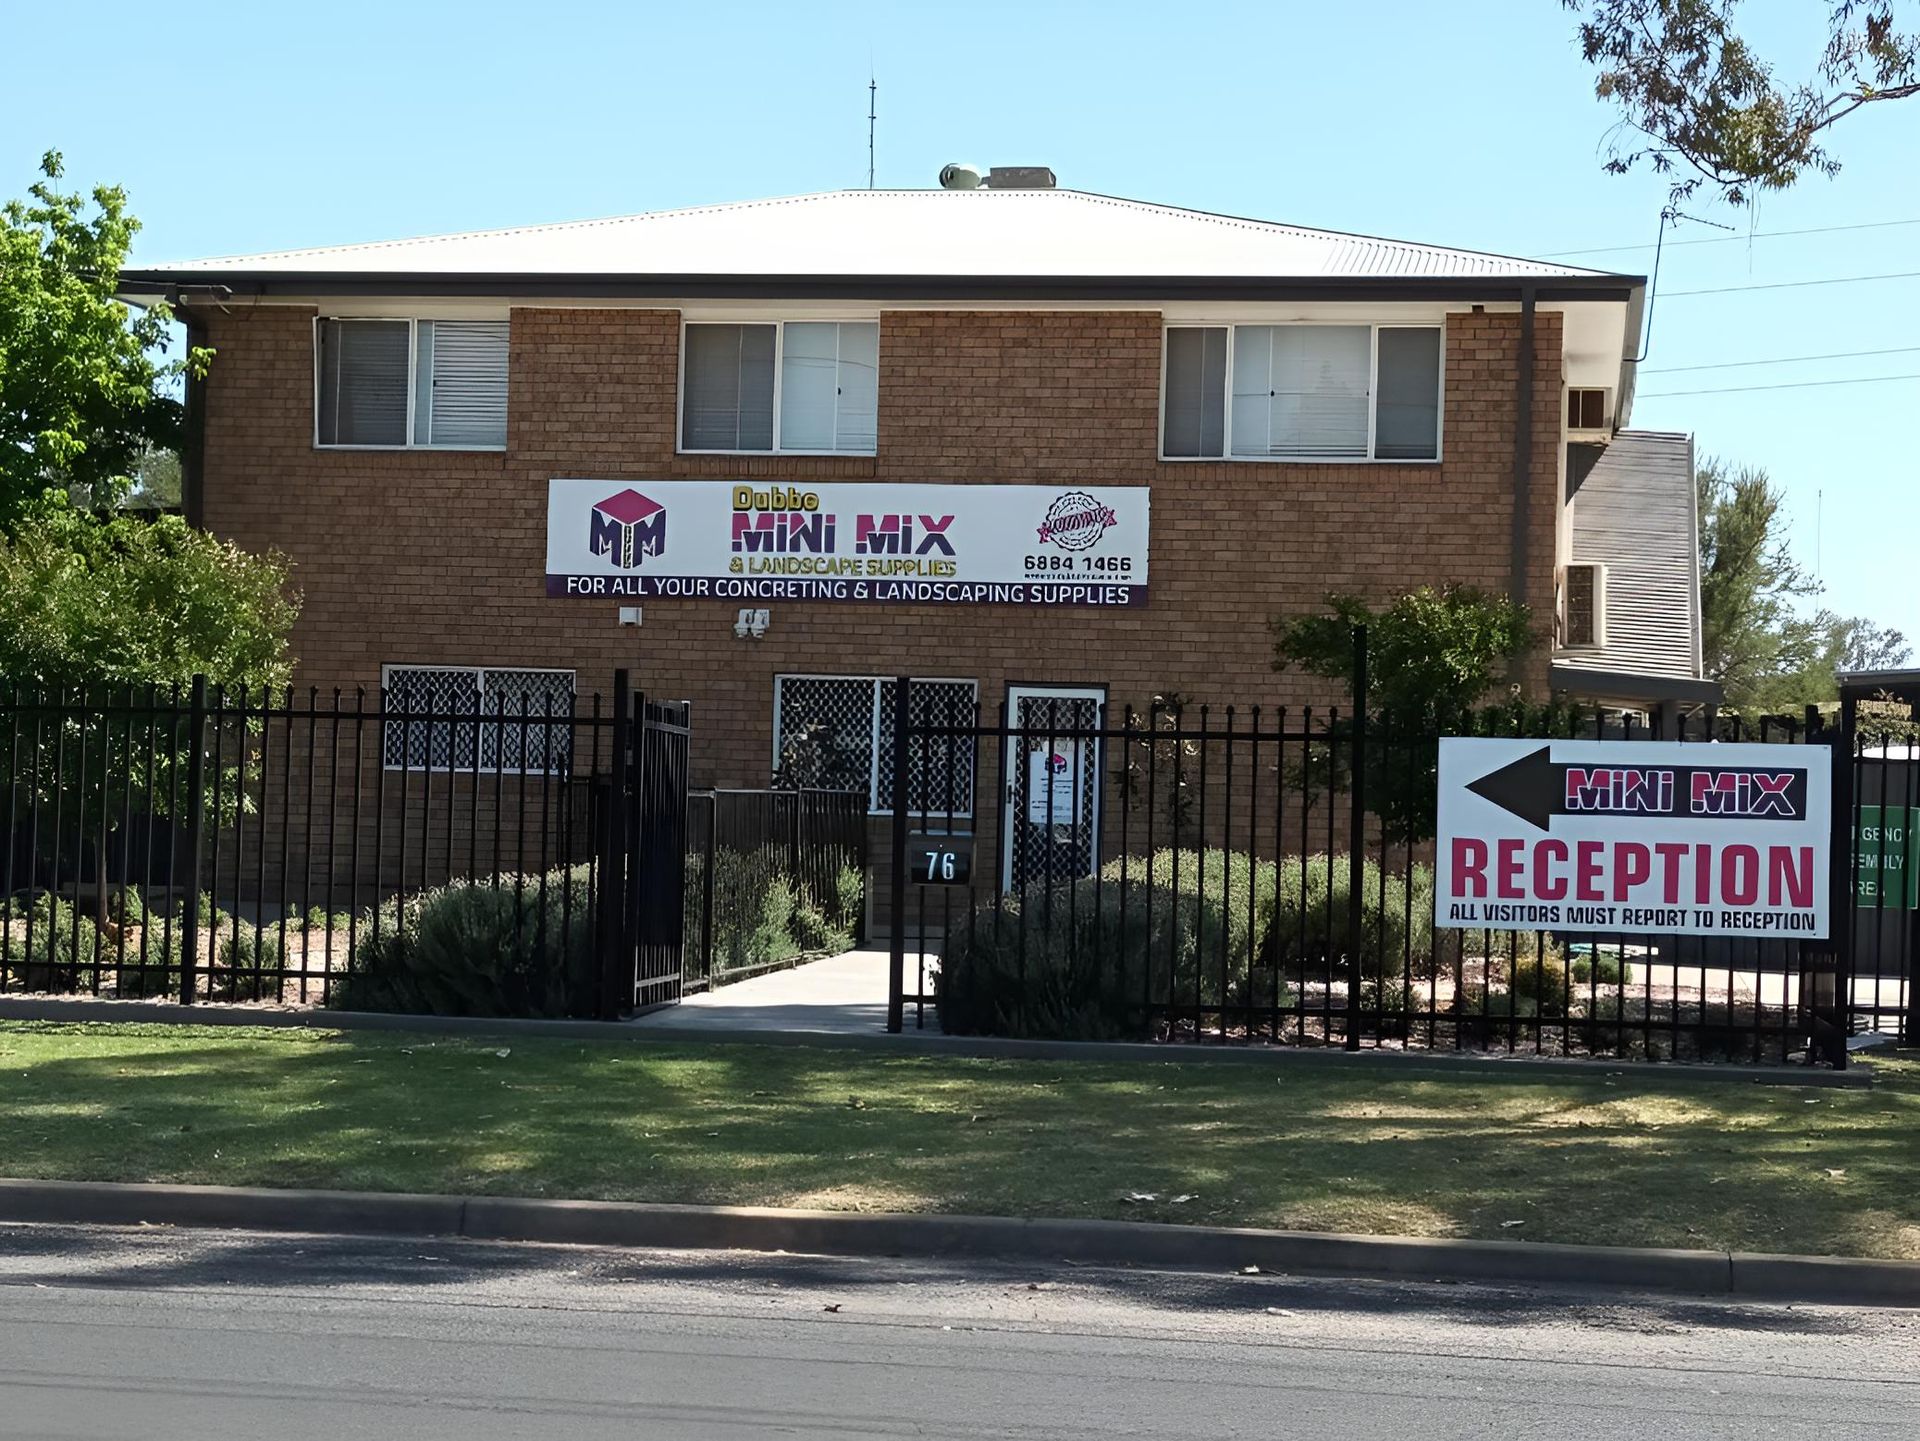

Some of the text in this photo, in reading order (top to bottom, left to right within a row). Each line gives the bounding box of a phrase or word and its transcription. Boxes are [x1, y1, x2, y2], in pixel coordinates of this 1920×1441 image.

[732, 485, 819, 512] Dubbo
[729, 556, 957, 577] & LANDSCAPE SUPPLIES
[1024, 555, 1132, 572] 6884 1466
[567, 576, 1130, 605] FOR ALL YOUR CONCRETING & LANDSCAPING SUPPLIES
[926, 852, 956, 880] 76
[1451, 837, 1814, 908] RECEPTION
[1449, 903, 1816, 931] ALL VISITORS MUST REPORT TO RECEPTION
